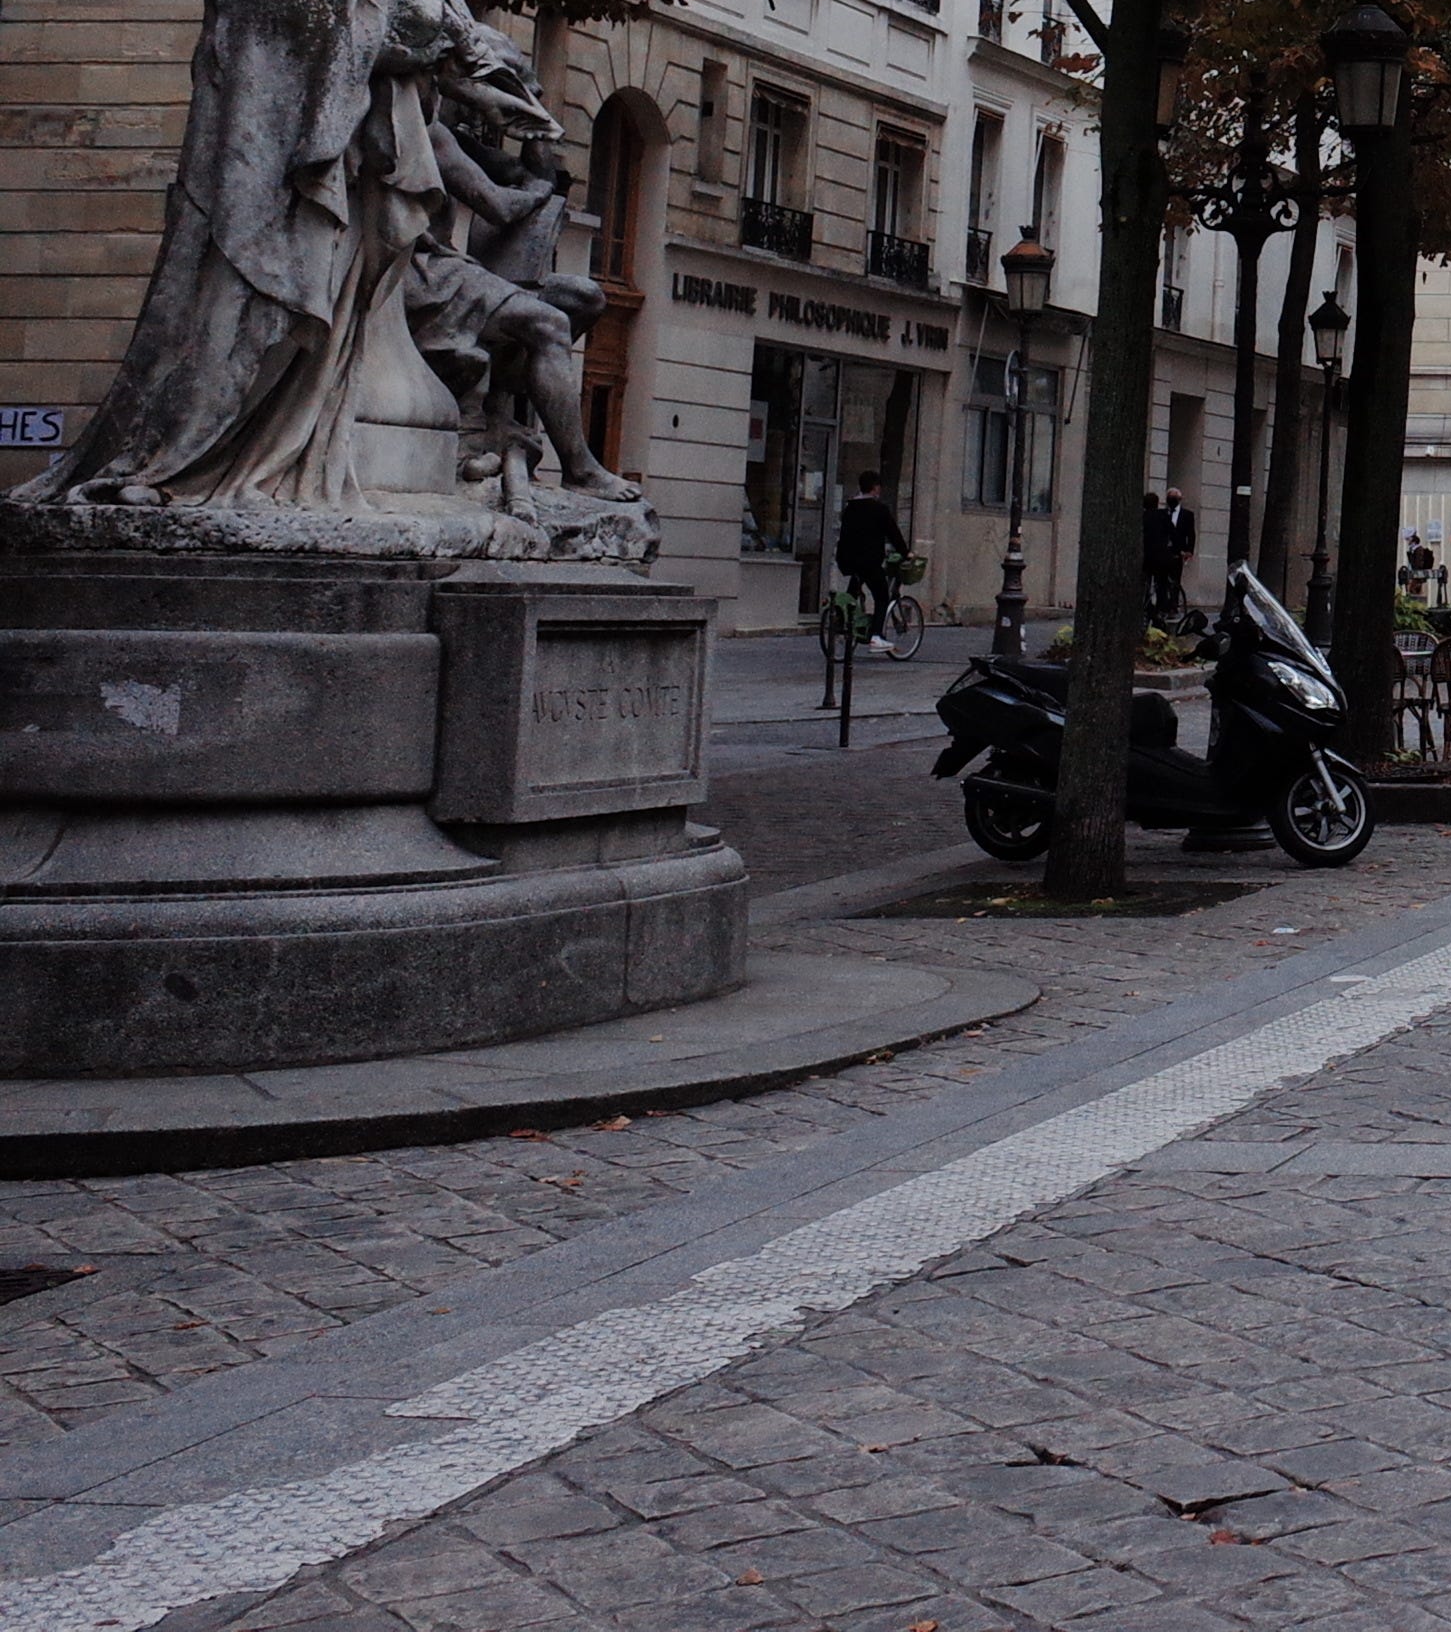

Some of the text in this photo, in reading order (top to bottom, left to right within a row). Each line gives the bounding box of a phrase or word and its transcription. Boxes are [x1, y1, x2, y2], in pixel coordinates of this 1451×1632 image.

[672, 272, 758, 316] LIBRAIRIE
[768, 292, 892, 343] PHILOSOPHIQUE
[901, 321, 913, 345] J.
